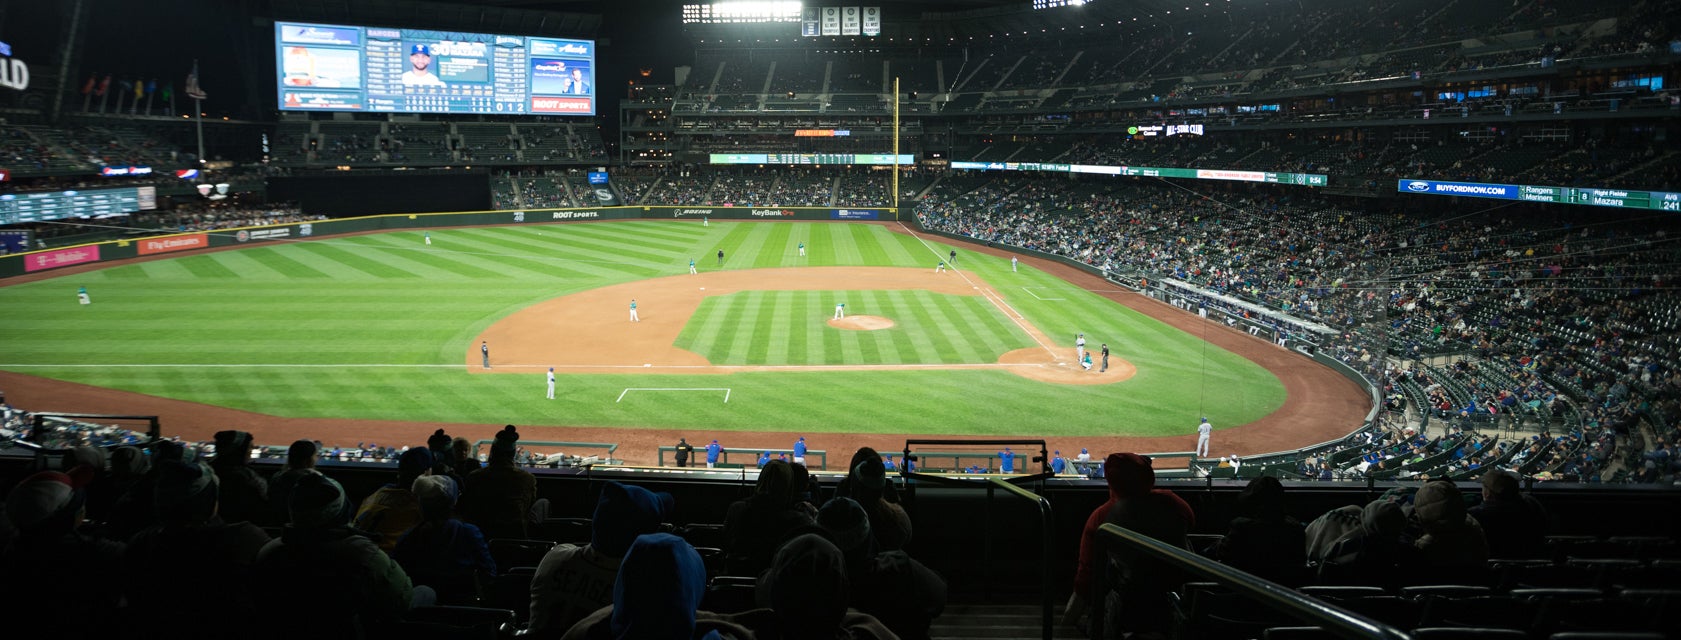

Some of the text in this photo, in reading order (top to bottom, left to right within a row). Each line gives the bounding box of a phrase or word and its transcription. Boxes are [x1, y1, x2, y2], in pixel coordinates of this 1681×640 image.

[430, 44, 450, 55] 30
[497, 103, 524, 111] 0 1 2
[1190, 124, 1203, 135] CLUB
[1436, 184, 1506, 195] BUYFORDNOW.COM
[1526, 186, 1553, 194] Rangers
[148, 238, 199, 250] Fly Emirates
